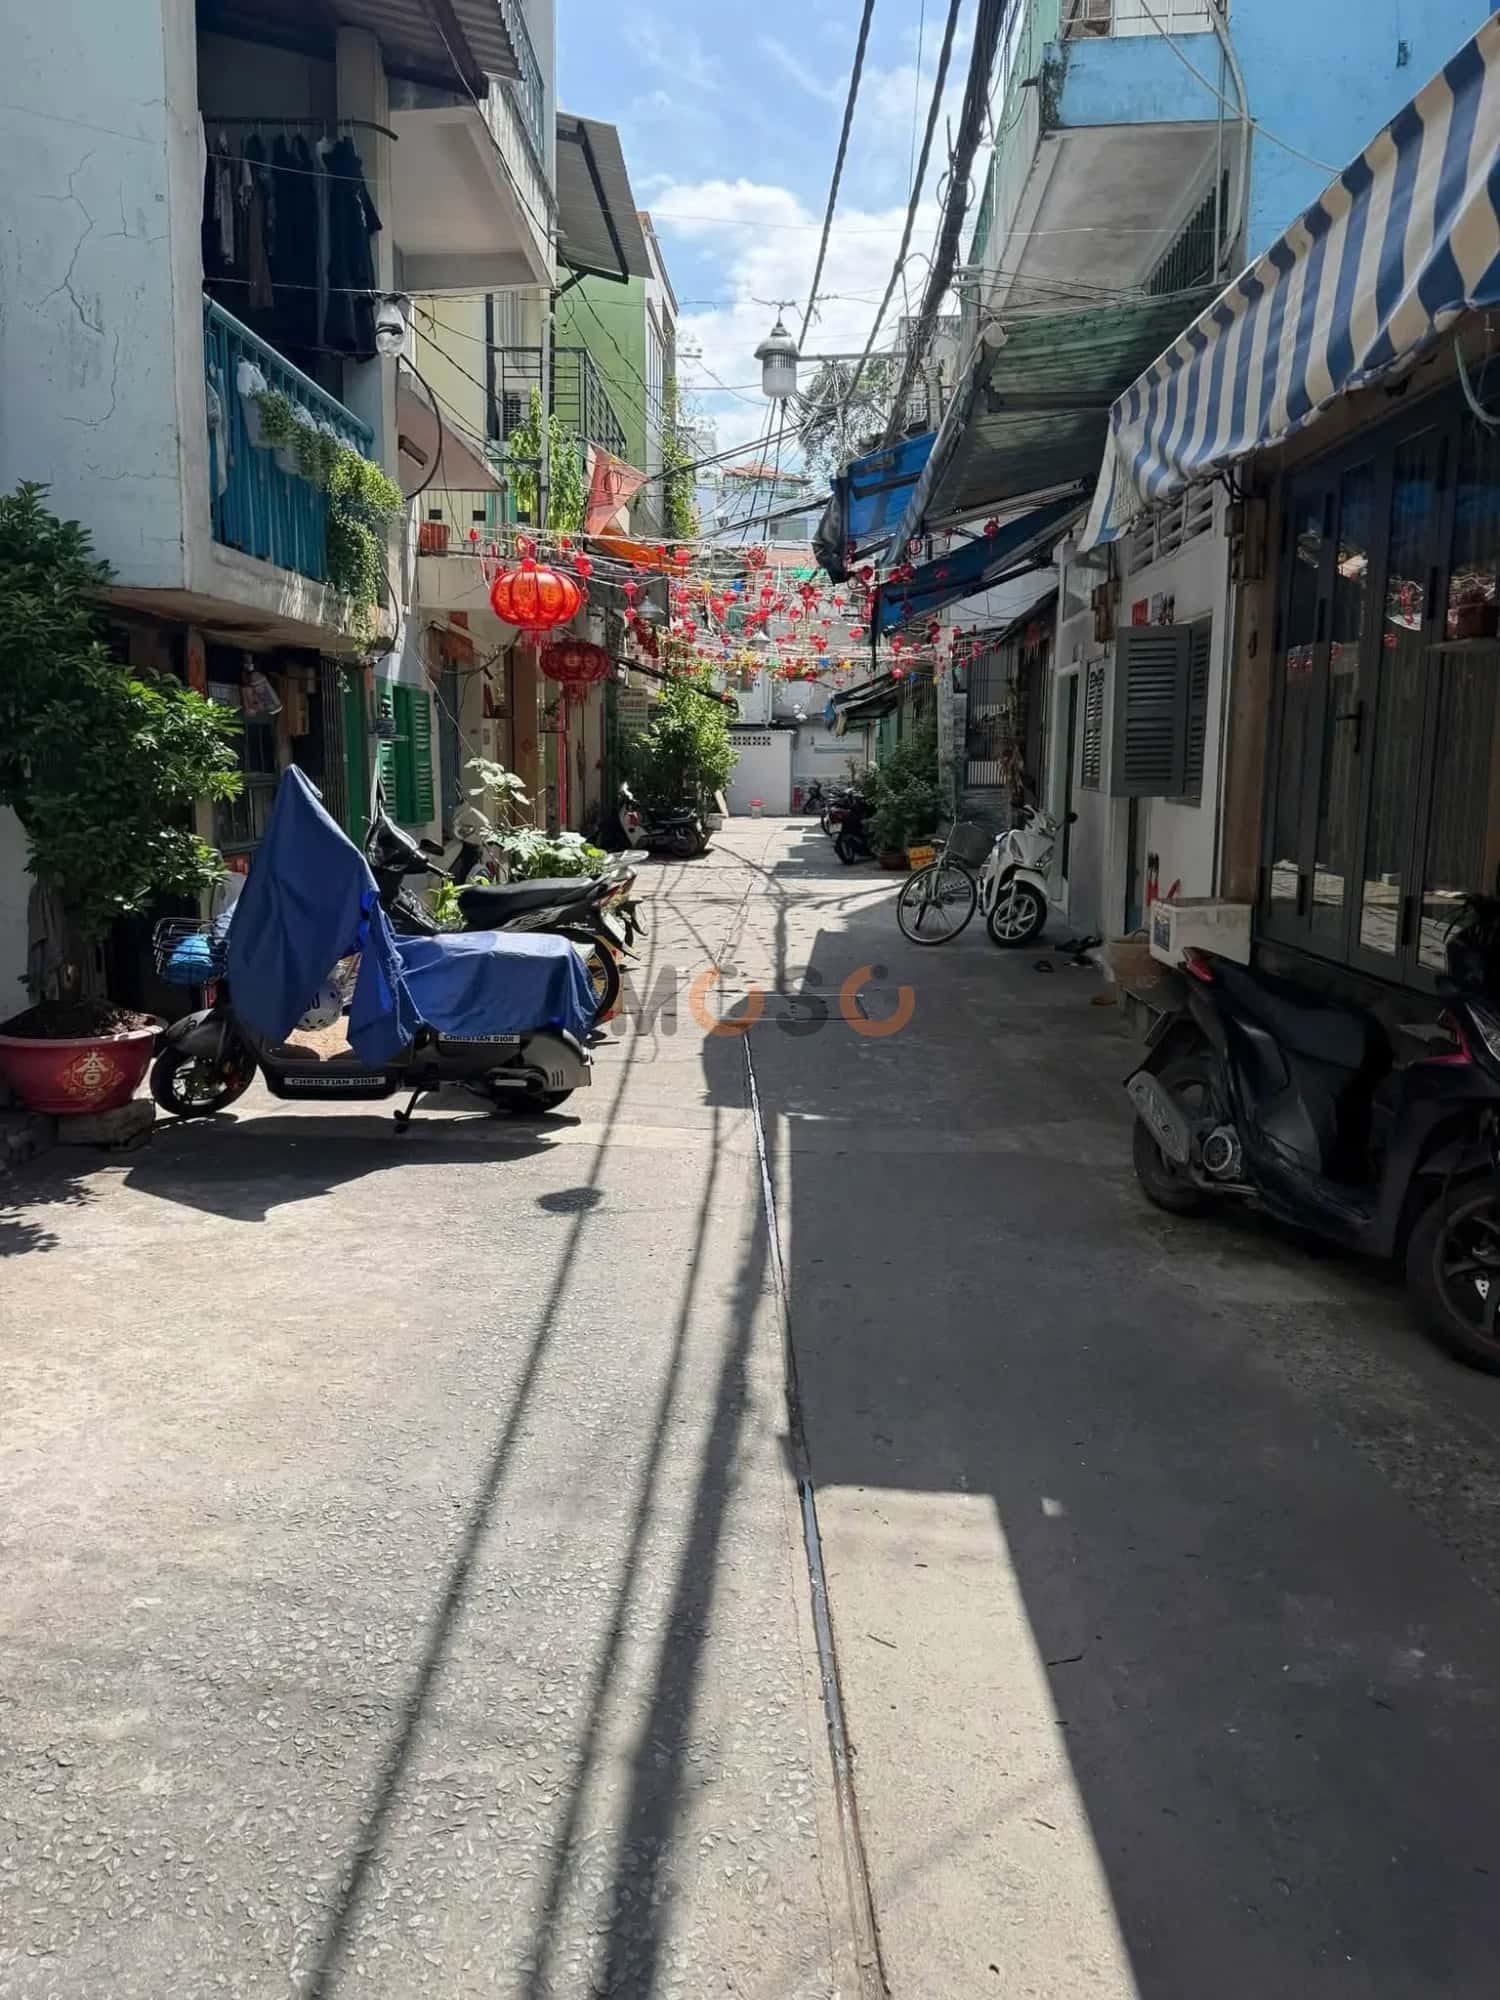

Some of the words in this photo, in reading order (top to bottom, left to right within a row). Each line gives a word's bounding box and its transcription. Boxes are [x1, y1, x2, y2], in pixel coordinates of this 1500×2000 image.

[444, 1034, 491, 1042] CHRISTIAN
[291, 1078, 350, 1086] CHRISTIAN
[353, 1077, 379, 1086] DIOR
